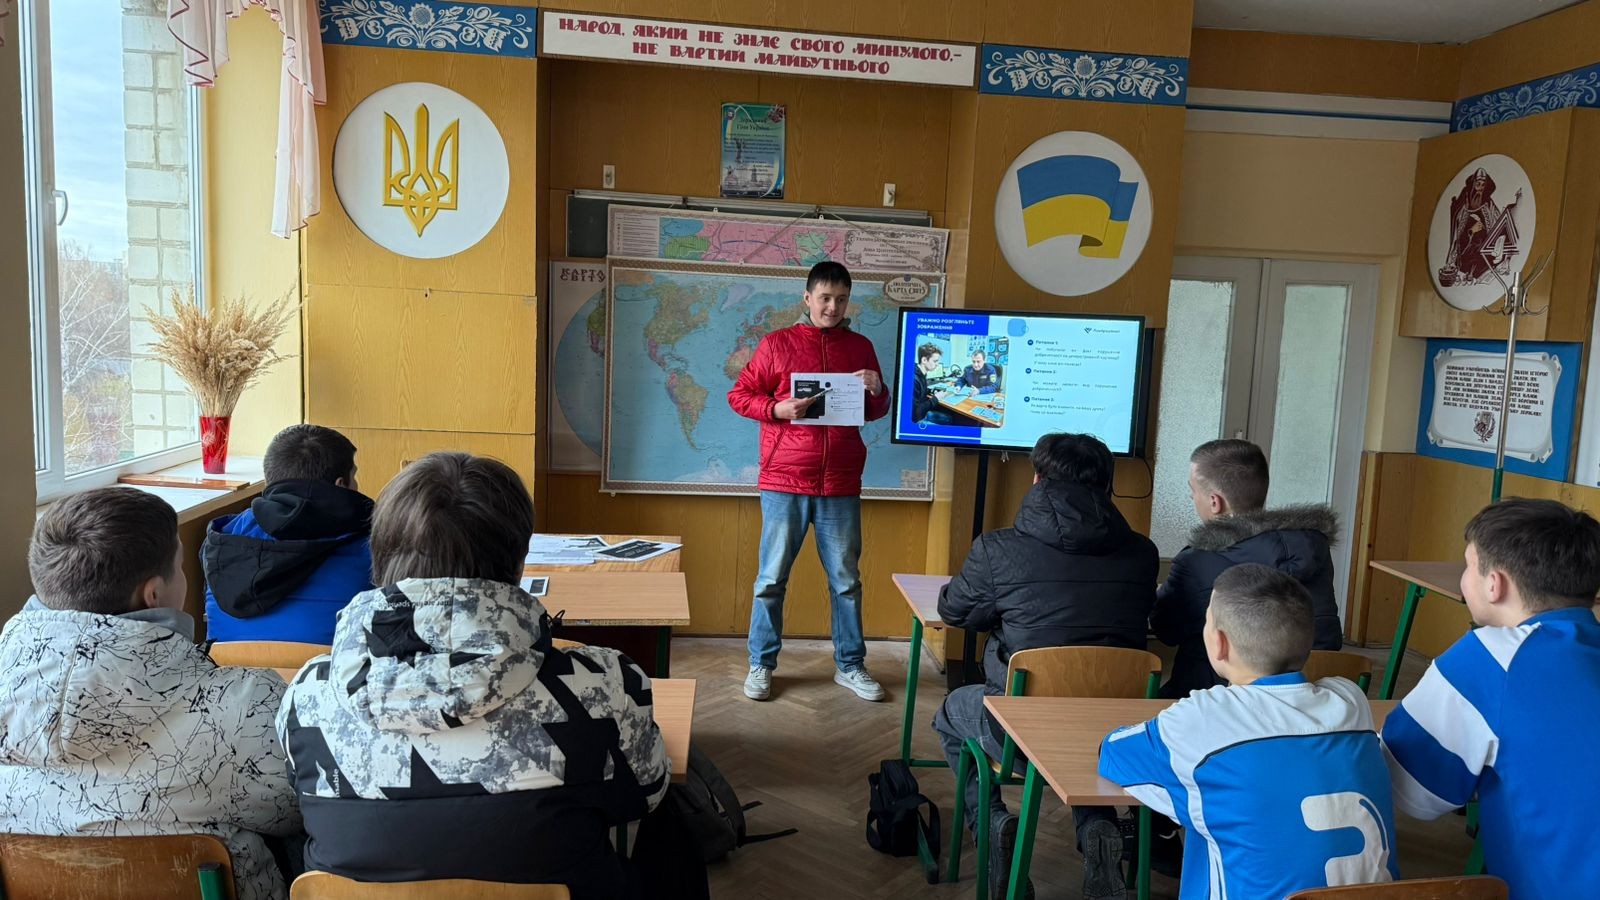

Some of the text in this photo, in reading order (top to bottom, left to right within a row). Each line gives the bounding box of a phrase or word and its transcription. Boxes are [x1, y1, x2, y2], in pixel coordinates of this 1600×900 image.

[633, 25, 688, 40] ЯКИЙ
[699, 31, 724, 44] НЕ
[733, 33, 780, 49] ЗНАЄ
[790, 37, 845, 55] СВОГО
[633, 42, 890, 74] НЕ ВАРТИЙ МАЙБУТНЬОГО
[560, 274, 606, 283] СВІТУ
[561, 268, 606, 276] КАРТА
